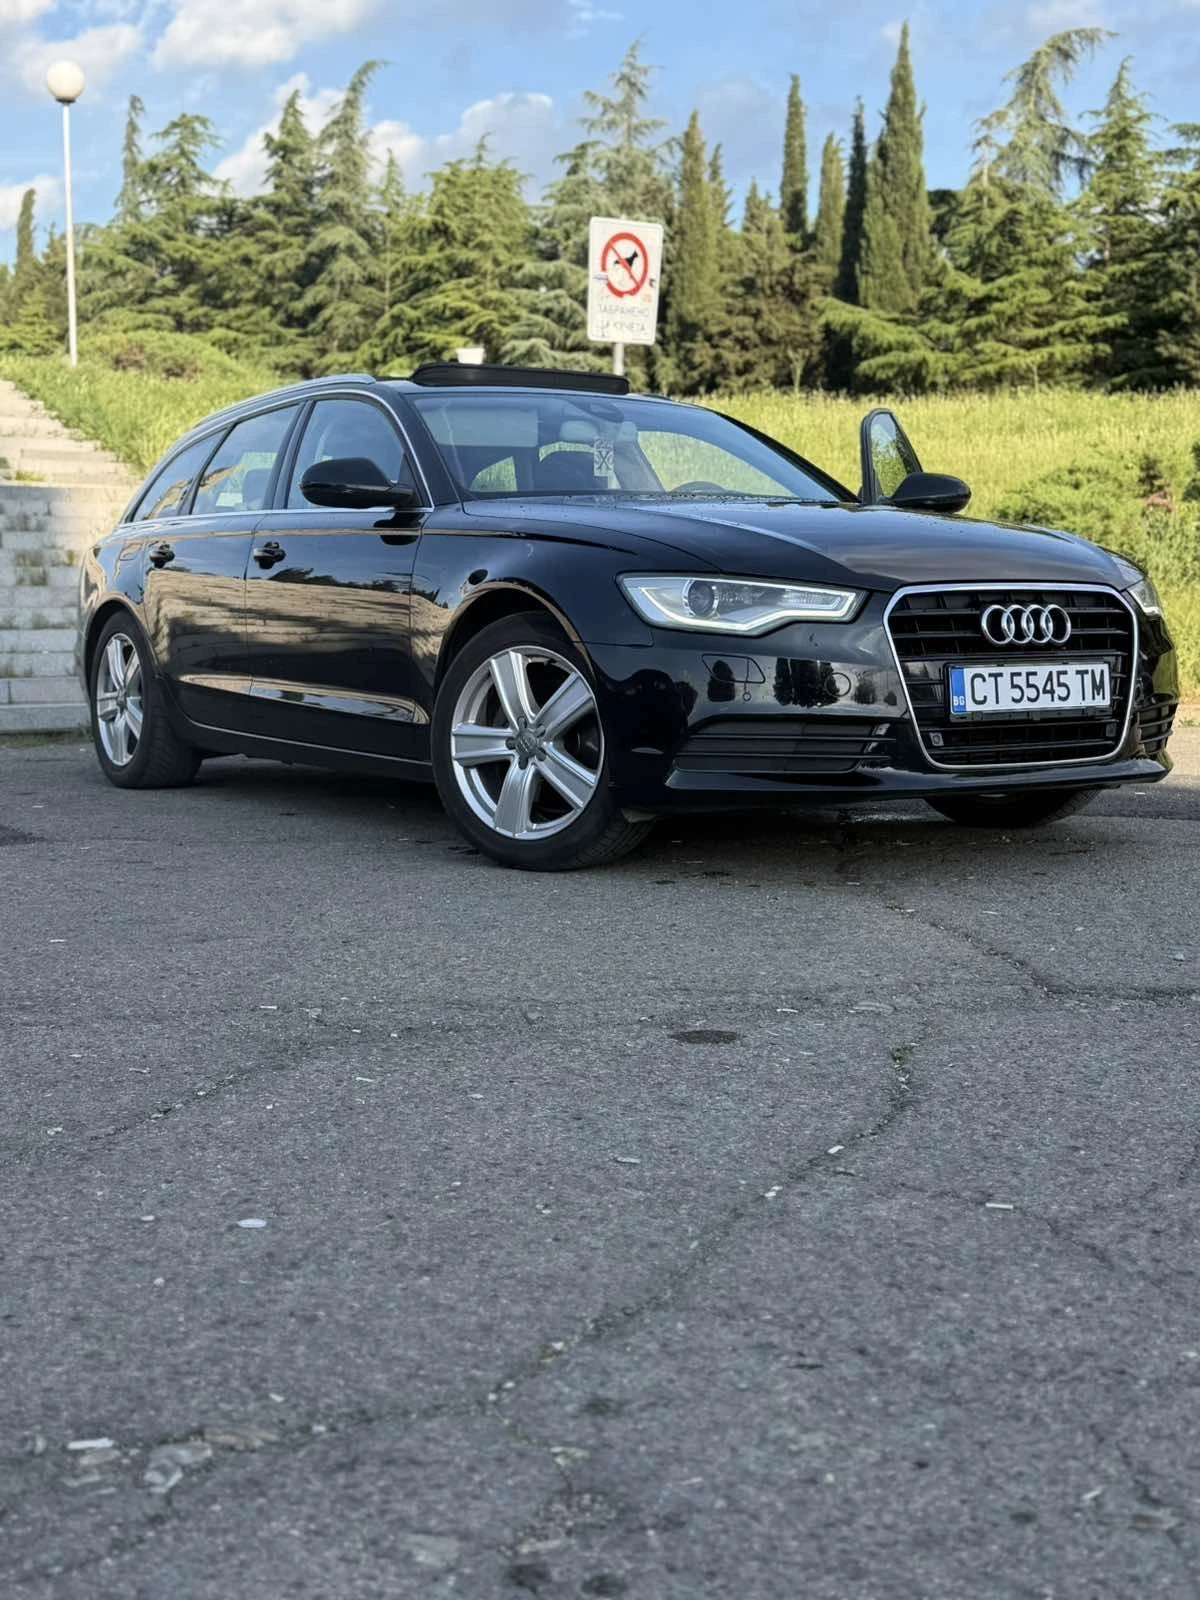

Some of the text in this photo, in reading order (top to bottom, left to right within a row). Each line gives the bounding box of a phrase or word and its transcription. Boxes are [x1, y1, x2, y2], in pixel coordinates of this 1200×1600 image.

[970, 669, 1106, 705] CT 5545 TM
[952, 695, 965, 706] BG
